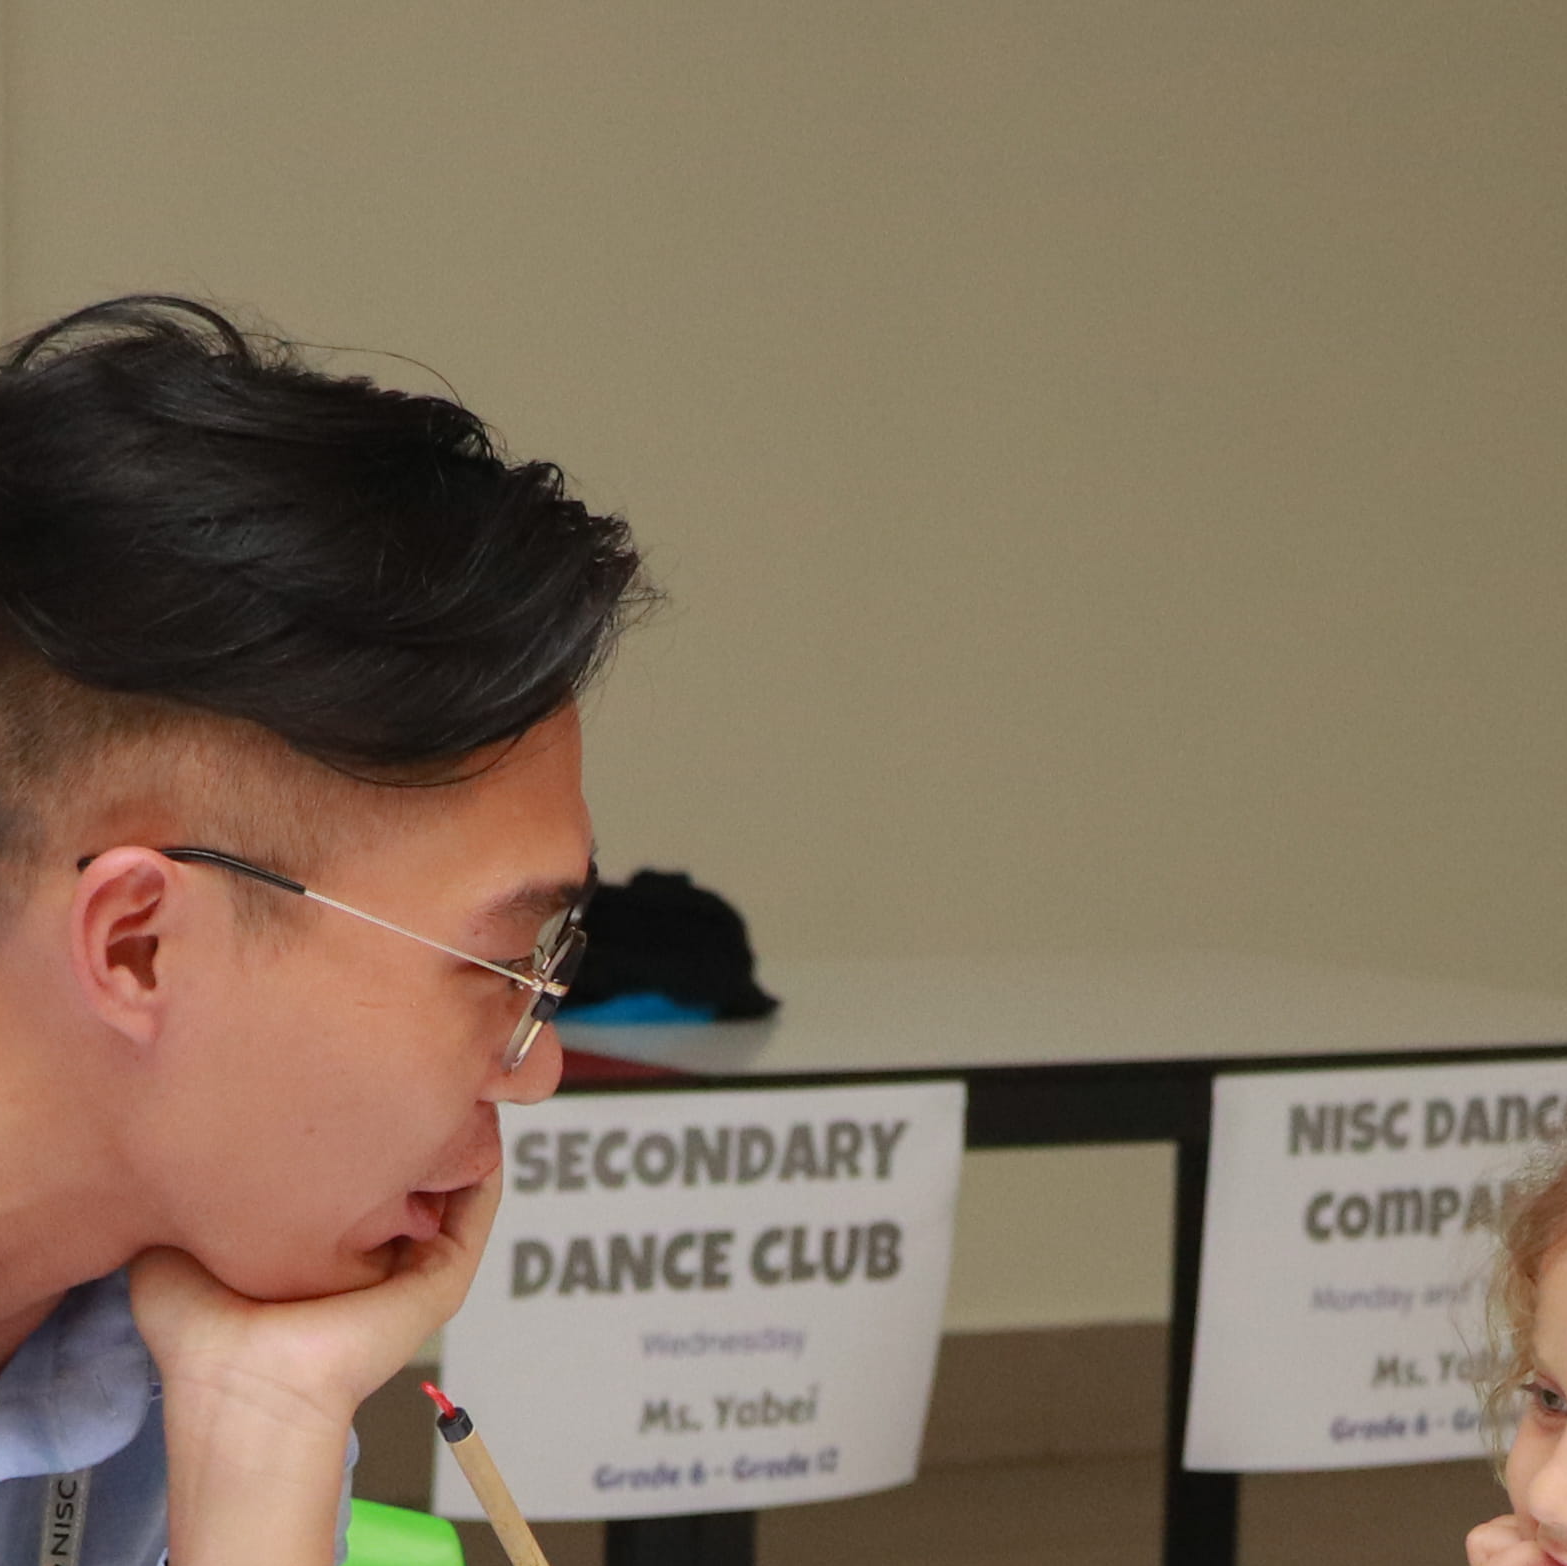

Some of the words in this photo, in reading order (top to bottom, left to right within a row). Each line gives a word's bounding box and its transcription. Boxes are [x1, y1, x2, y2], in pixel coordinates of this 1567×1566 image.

[513, 1120, 910, 1193] SECONDARY
[1289, 1102, 1409, 1156] NISC
[509, 1229, 735, 1299] DANCE
[750, 1222, 902, 1285] CLUB
[642, 1329, 805, 1358] Wednesday
[593, 1463, 680, 1491] Grade
[733, 1454, 809, 1481] Grade
[51, 1478, 77, 1556] NISC
